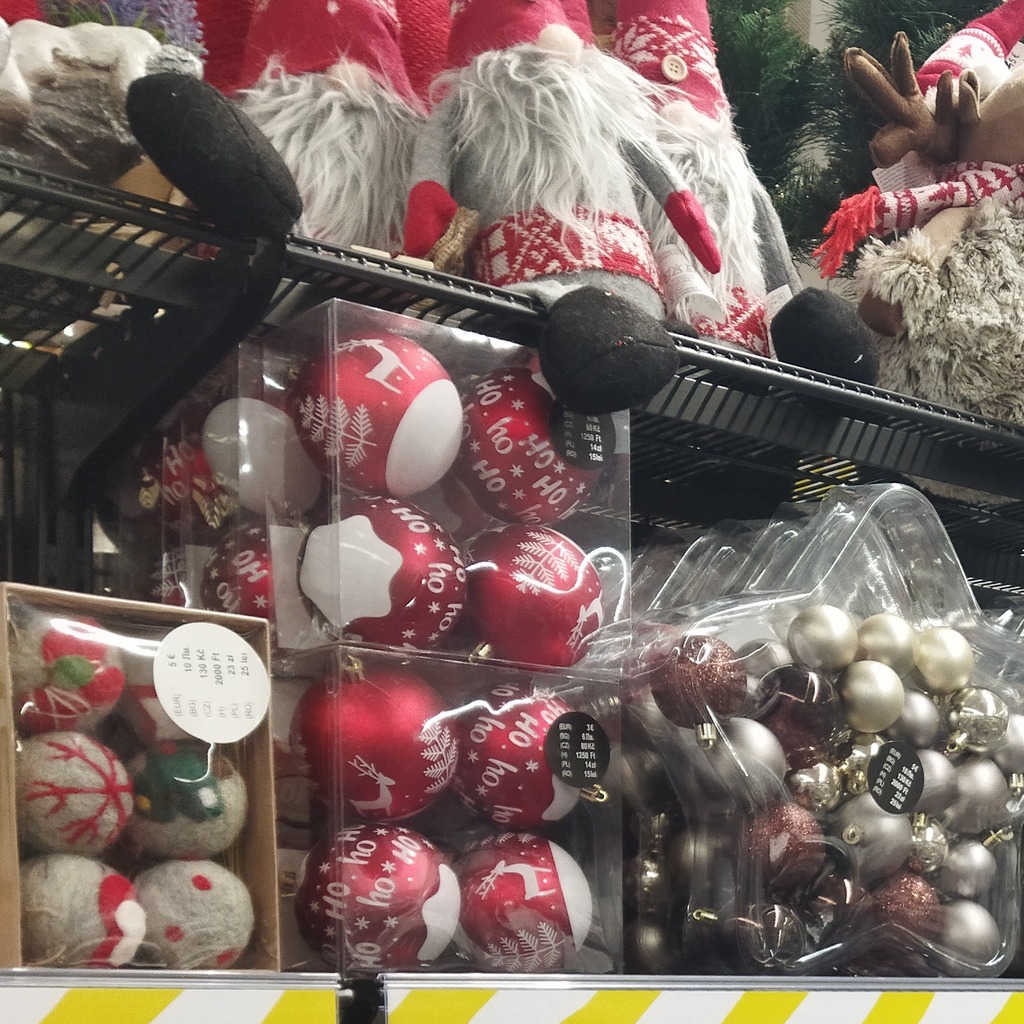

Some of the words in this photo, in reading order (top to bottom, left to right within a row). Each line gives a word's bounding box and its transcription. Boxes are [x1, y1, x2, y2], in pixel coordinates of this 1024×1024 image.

[487, 416, 513, 454] ho
[472, 460, 505, 492] HO
[532, 475, 568, 504] HO
[391, 508, 429, 533] HO
[232, 550, 268, 582] HO
[428, 563, 453, 593] ho
[439, 603, 462, 631] ho
[184, 663, 192, 672] 10
[212, 652, 220, 661] Ft
[199, 663, 207, 679] 130
[212, 664, 223, 685] 2000
[228, 664, 235, 675] 23
[242, 663, 249, 676] 25
[173, 693, 183, 716] (EUR)
[189, 700, 198, 717] (BG)
[203, 701, 211, 717] (CZ)
[231, 704, 240, 718] (PL)
[244, 702, 254, 719] (RO)
[470, 716, 506, 743] ho
[509, 712, 539, 748] HO
[482, 758, 518, 787] ho
[336, 840, 376, 865] ho
[391, 836, 422, 864] HO
[322, 882, 350, 920] HO
[356, 877, 395, 907] ho
